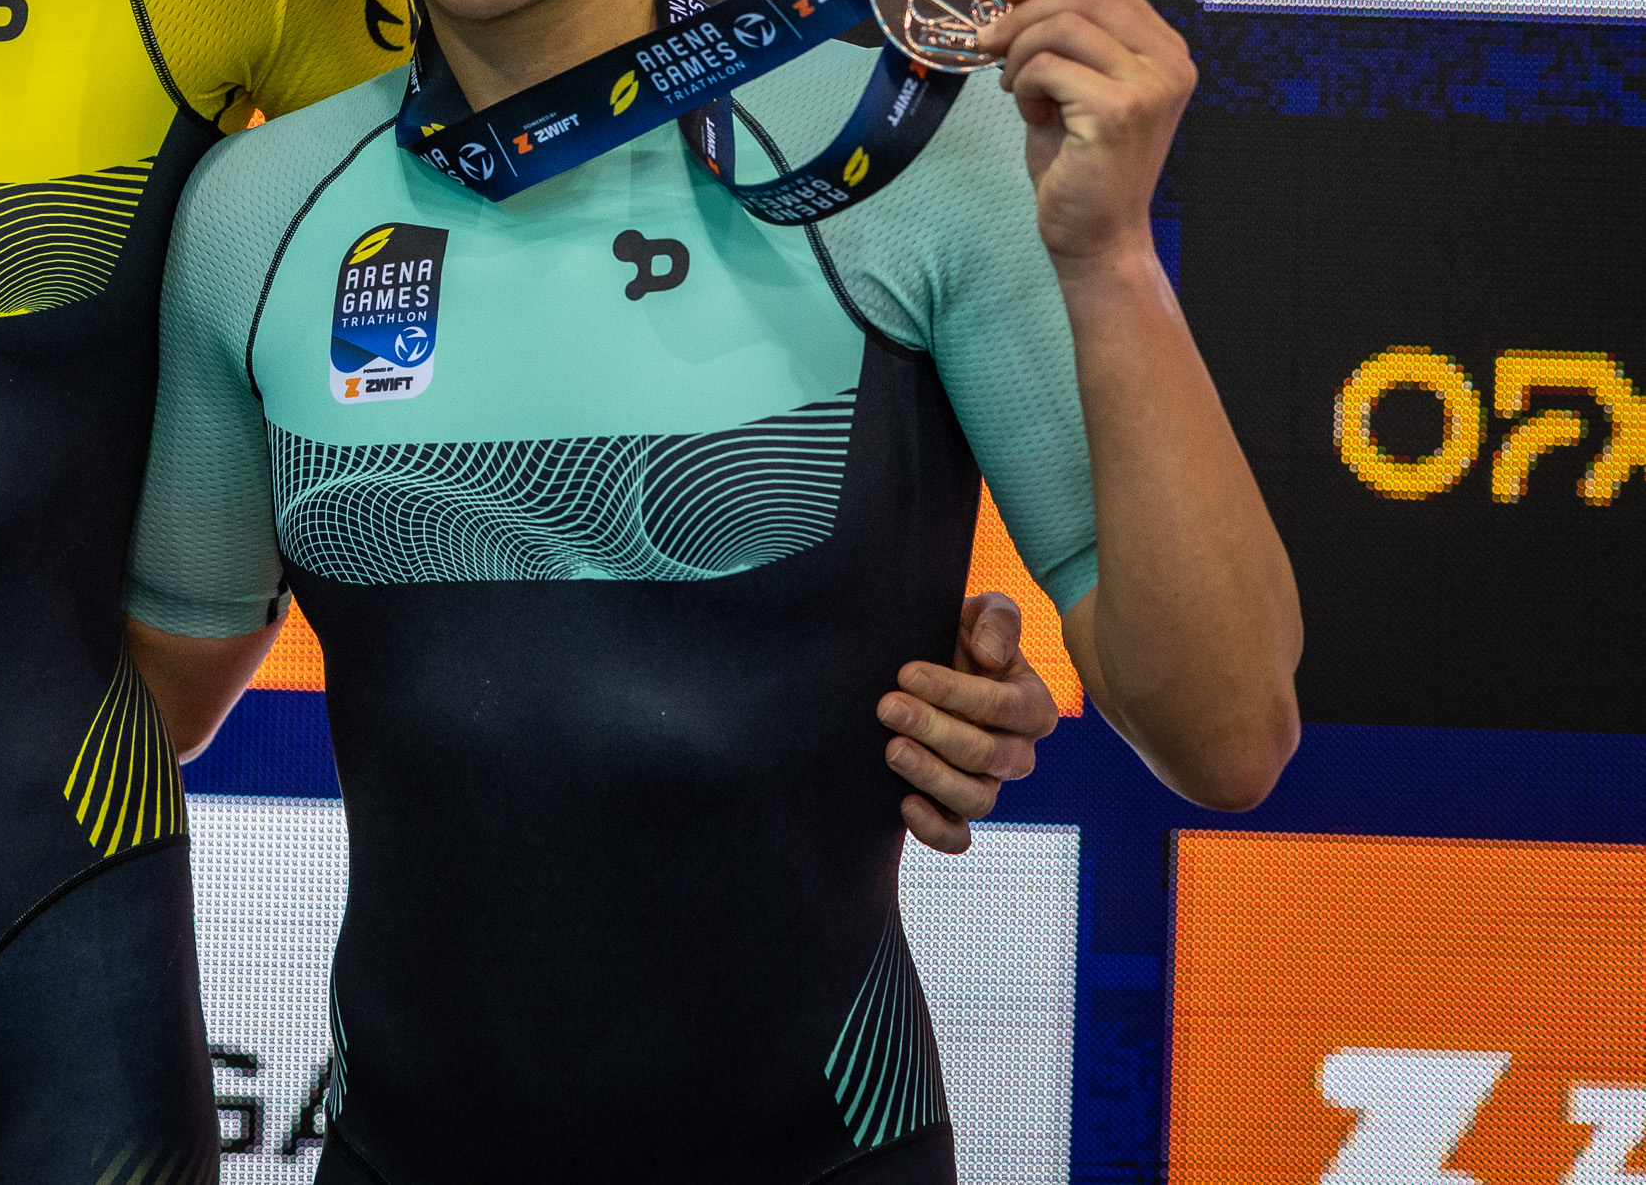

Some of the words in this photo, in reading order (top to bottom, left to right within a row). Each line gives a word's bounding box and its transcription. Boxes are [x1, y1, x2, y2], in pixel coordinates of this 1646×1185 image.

[635, 21, 723, 73] ARENA
[650, 41, 738, 92] GAMES
[665, 60, 747, 105] TRIATHLON
[886, 77, 920, 128] ZWIFT
[534, 113, 580, 143] ZWIFT
[345, 259, 433, 291] ARENA
[342, 284, 430, 314] GAMES
[341, 310, 427, 328] TRIATHLON
[365, 376, 414, 393] ZWIFT
